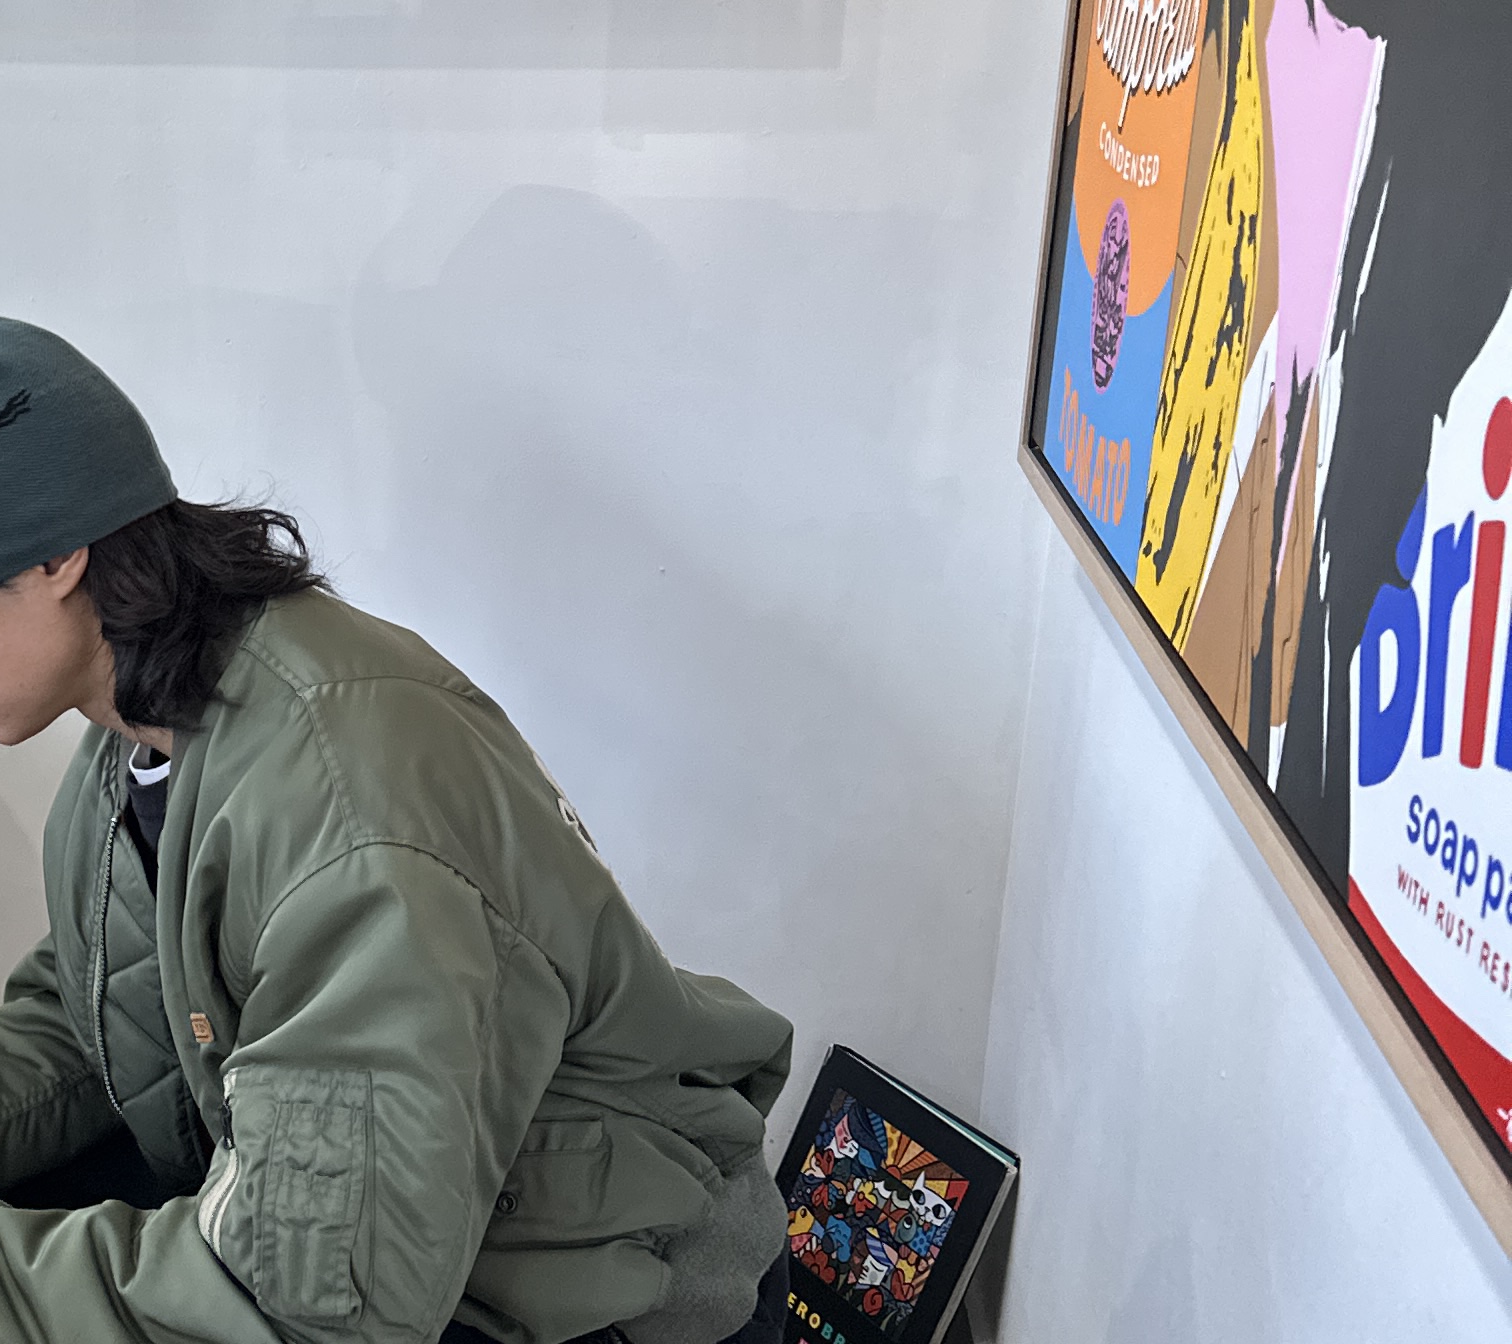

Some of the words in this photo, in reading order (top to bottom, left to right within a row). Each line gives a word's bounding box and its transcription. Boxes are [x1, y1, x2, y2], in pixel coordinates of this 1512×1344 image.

[1099, 121, 1161, 188] CONDENSED
[1059, 368, 1131, 528] TOMATO
[1406, 794, 1479, 898] soap
[1397, 863, 1431, 917] WITH
[1435, 901, 1474, 955] RUST
[1479, 941, 1512, 998] RES
